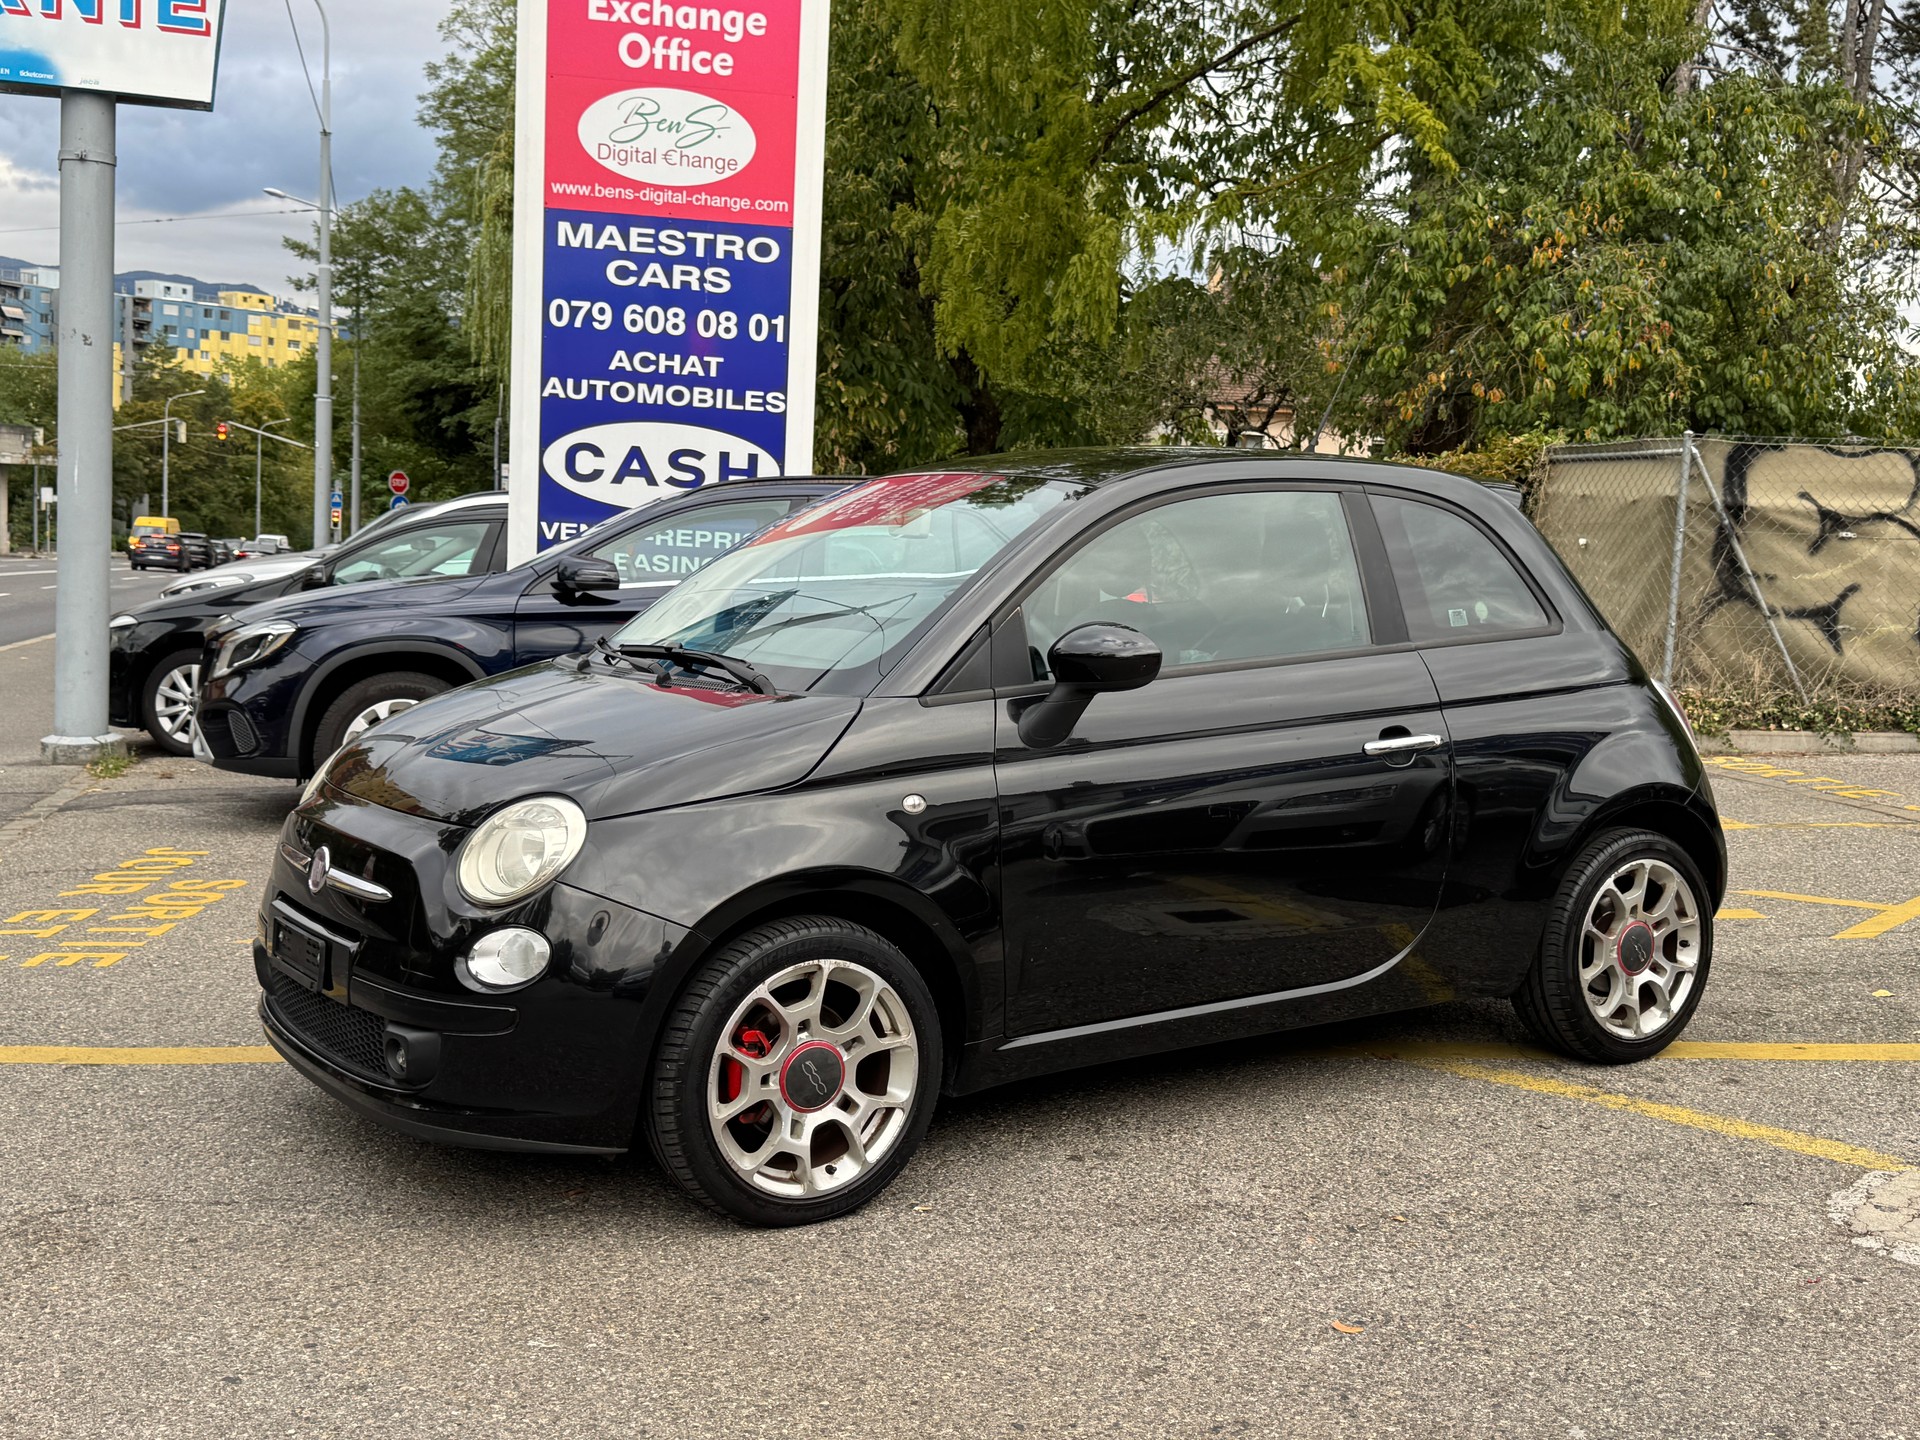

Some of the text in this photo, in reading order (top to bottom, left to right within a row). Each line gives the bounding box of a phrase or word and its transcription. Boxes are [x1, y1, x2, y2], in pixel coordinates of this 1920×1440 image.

[587, 0, 767, 43] Exchange
[19, 69, 54, 79] ticketcorner
[617, 32, 734, 76] Office
[597, 143, 657, 166] Digital
[551, 182, 789, 213] www.bens-digital-change.com
[557, 221, 780, 264] MAESTRO
[606, 259, 731, 293] CARS
[549, 298, 785, 343] 079 608 08 01
[608, 350, 724, 377] ACHAT
[542, 377, 786, 413] AUTOMOBILES
[565, 442, 759, 489] CASH
[58, 847, 209, 897] JOUR
[20, 879, 248, 968] SORTIE
